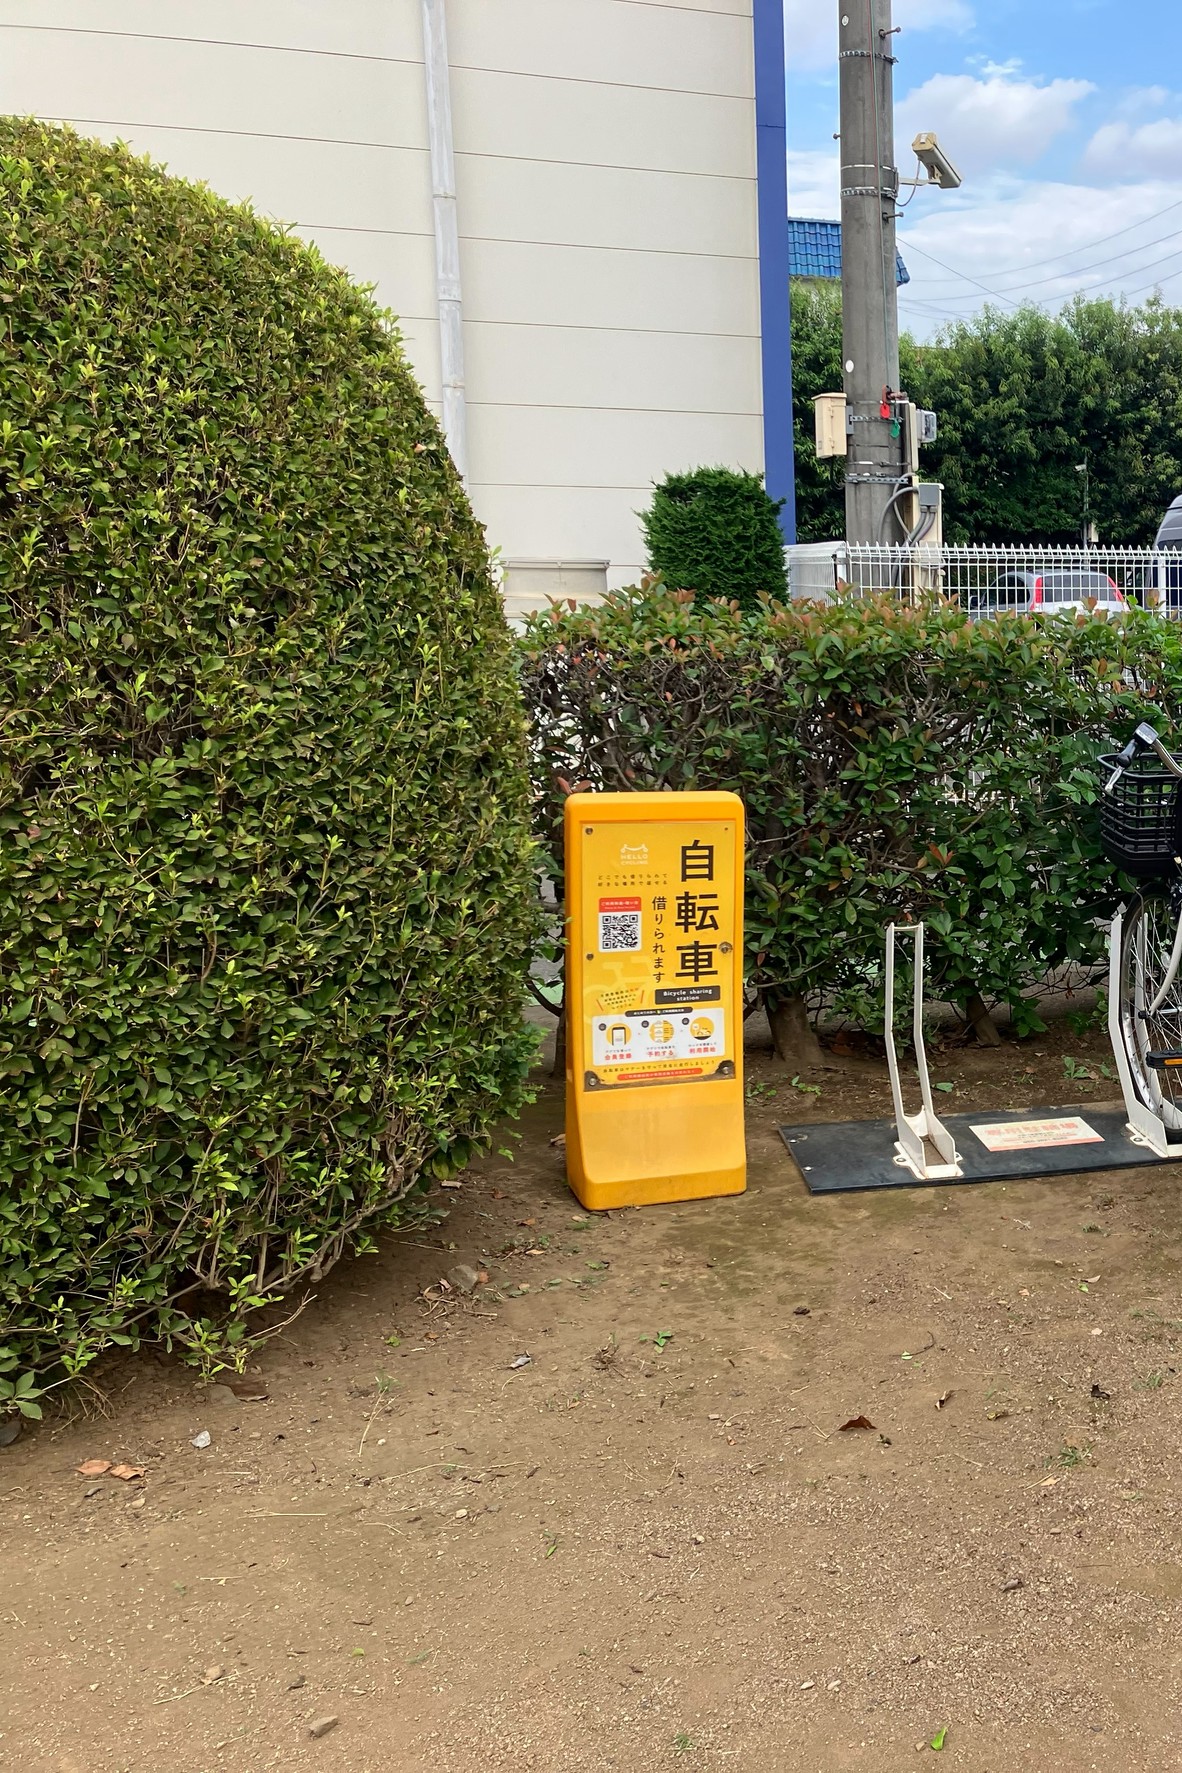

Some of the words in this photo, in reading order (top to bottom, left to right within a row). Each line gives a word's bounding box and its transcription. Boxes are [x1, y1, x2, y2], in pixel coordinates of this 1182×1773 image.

[674, 839, 720, 983] 自転車
[652, 896, 668, 984] 借りられます
[663, 989, 687, 997] Bicycle
[647, 1050, 674, 1058] 予約する
